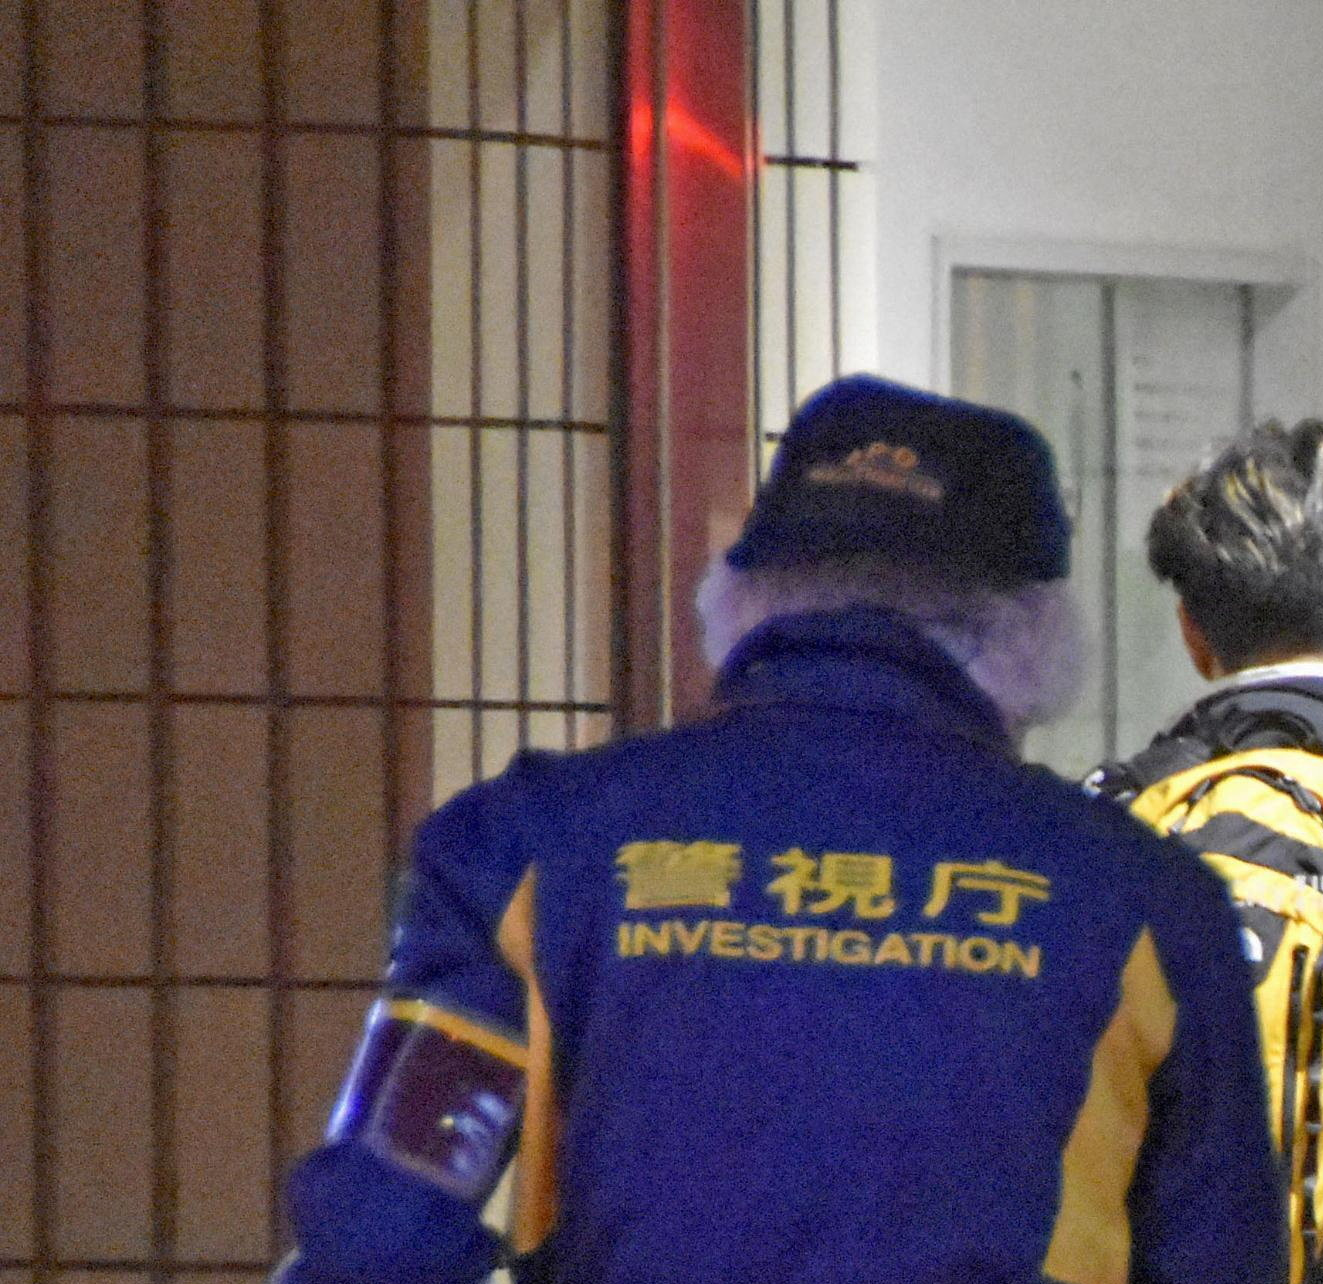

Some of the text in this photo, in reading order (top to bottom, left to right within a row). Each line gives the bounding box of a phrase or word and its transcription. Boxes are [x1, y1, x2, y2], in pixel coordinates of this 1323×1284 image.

[615, 838, 1051, 926] 警視庁
[616, 919, 1041, 979] INVESTIGATION
